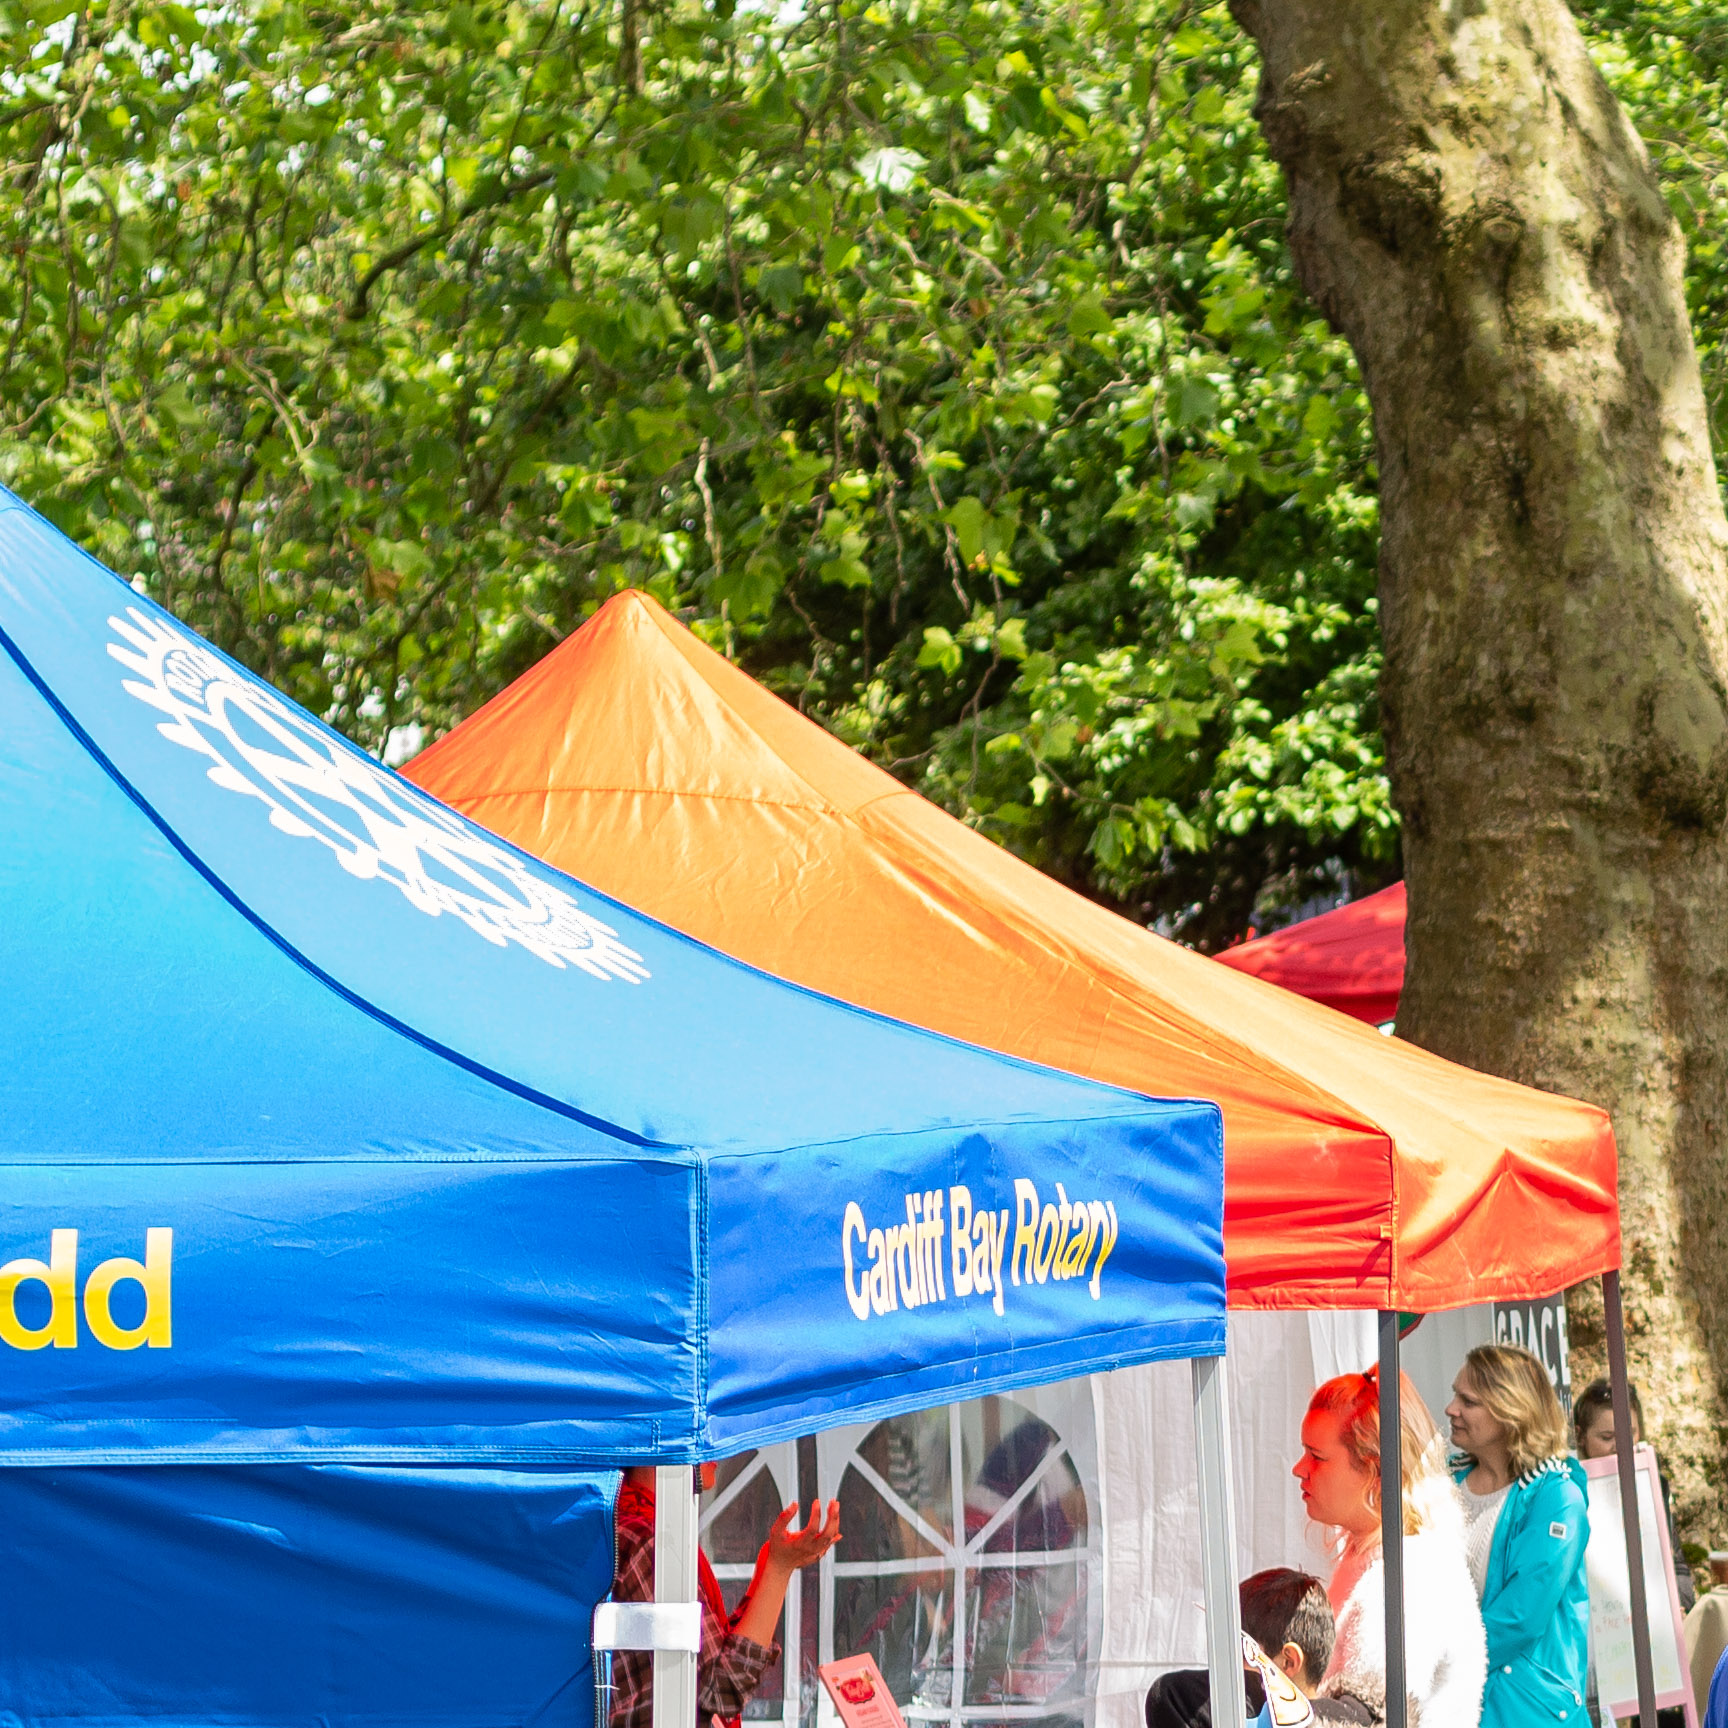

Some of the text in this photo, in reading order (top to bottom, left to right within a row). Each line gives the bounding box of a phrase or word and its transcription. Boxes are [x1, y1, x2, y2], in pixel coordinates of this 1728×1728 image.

[843, 1178, 1118, 1320] Cardiff Bay Rotary
